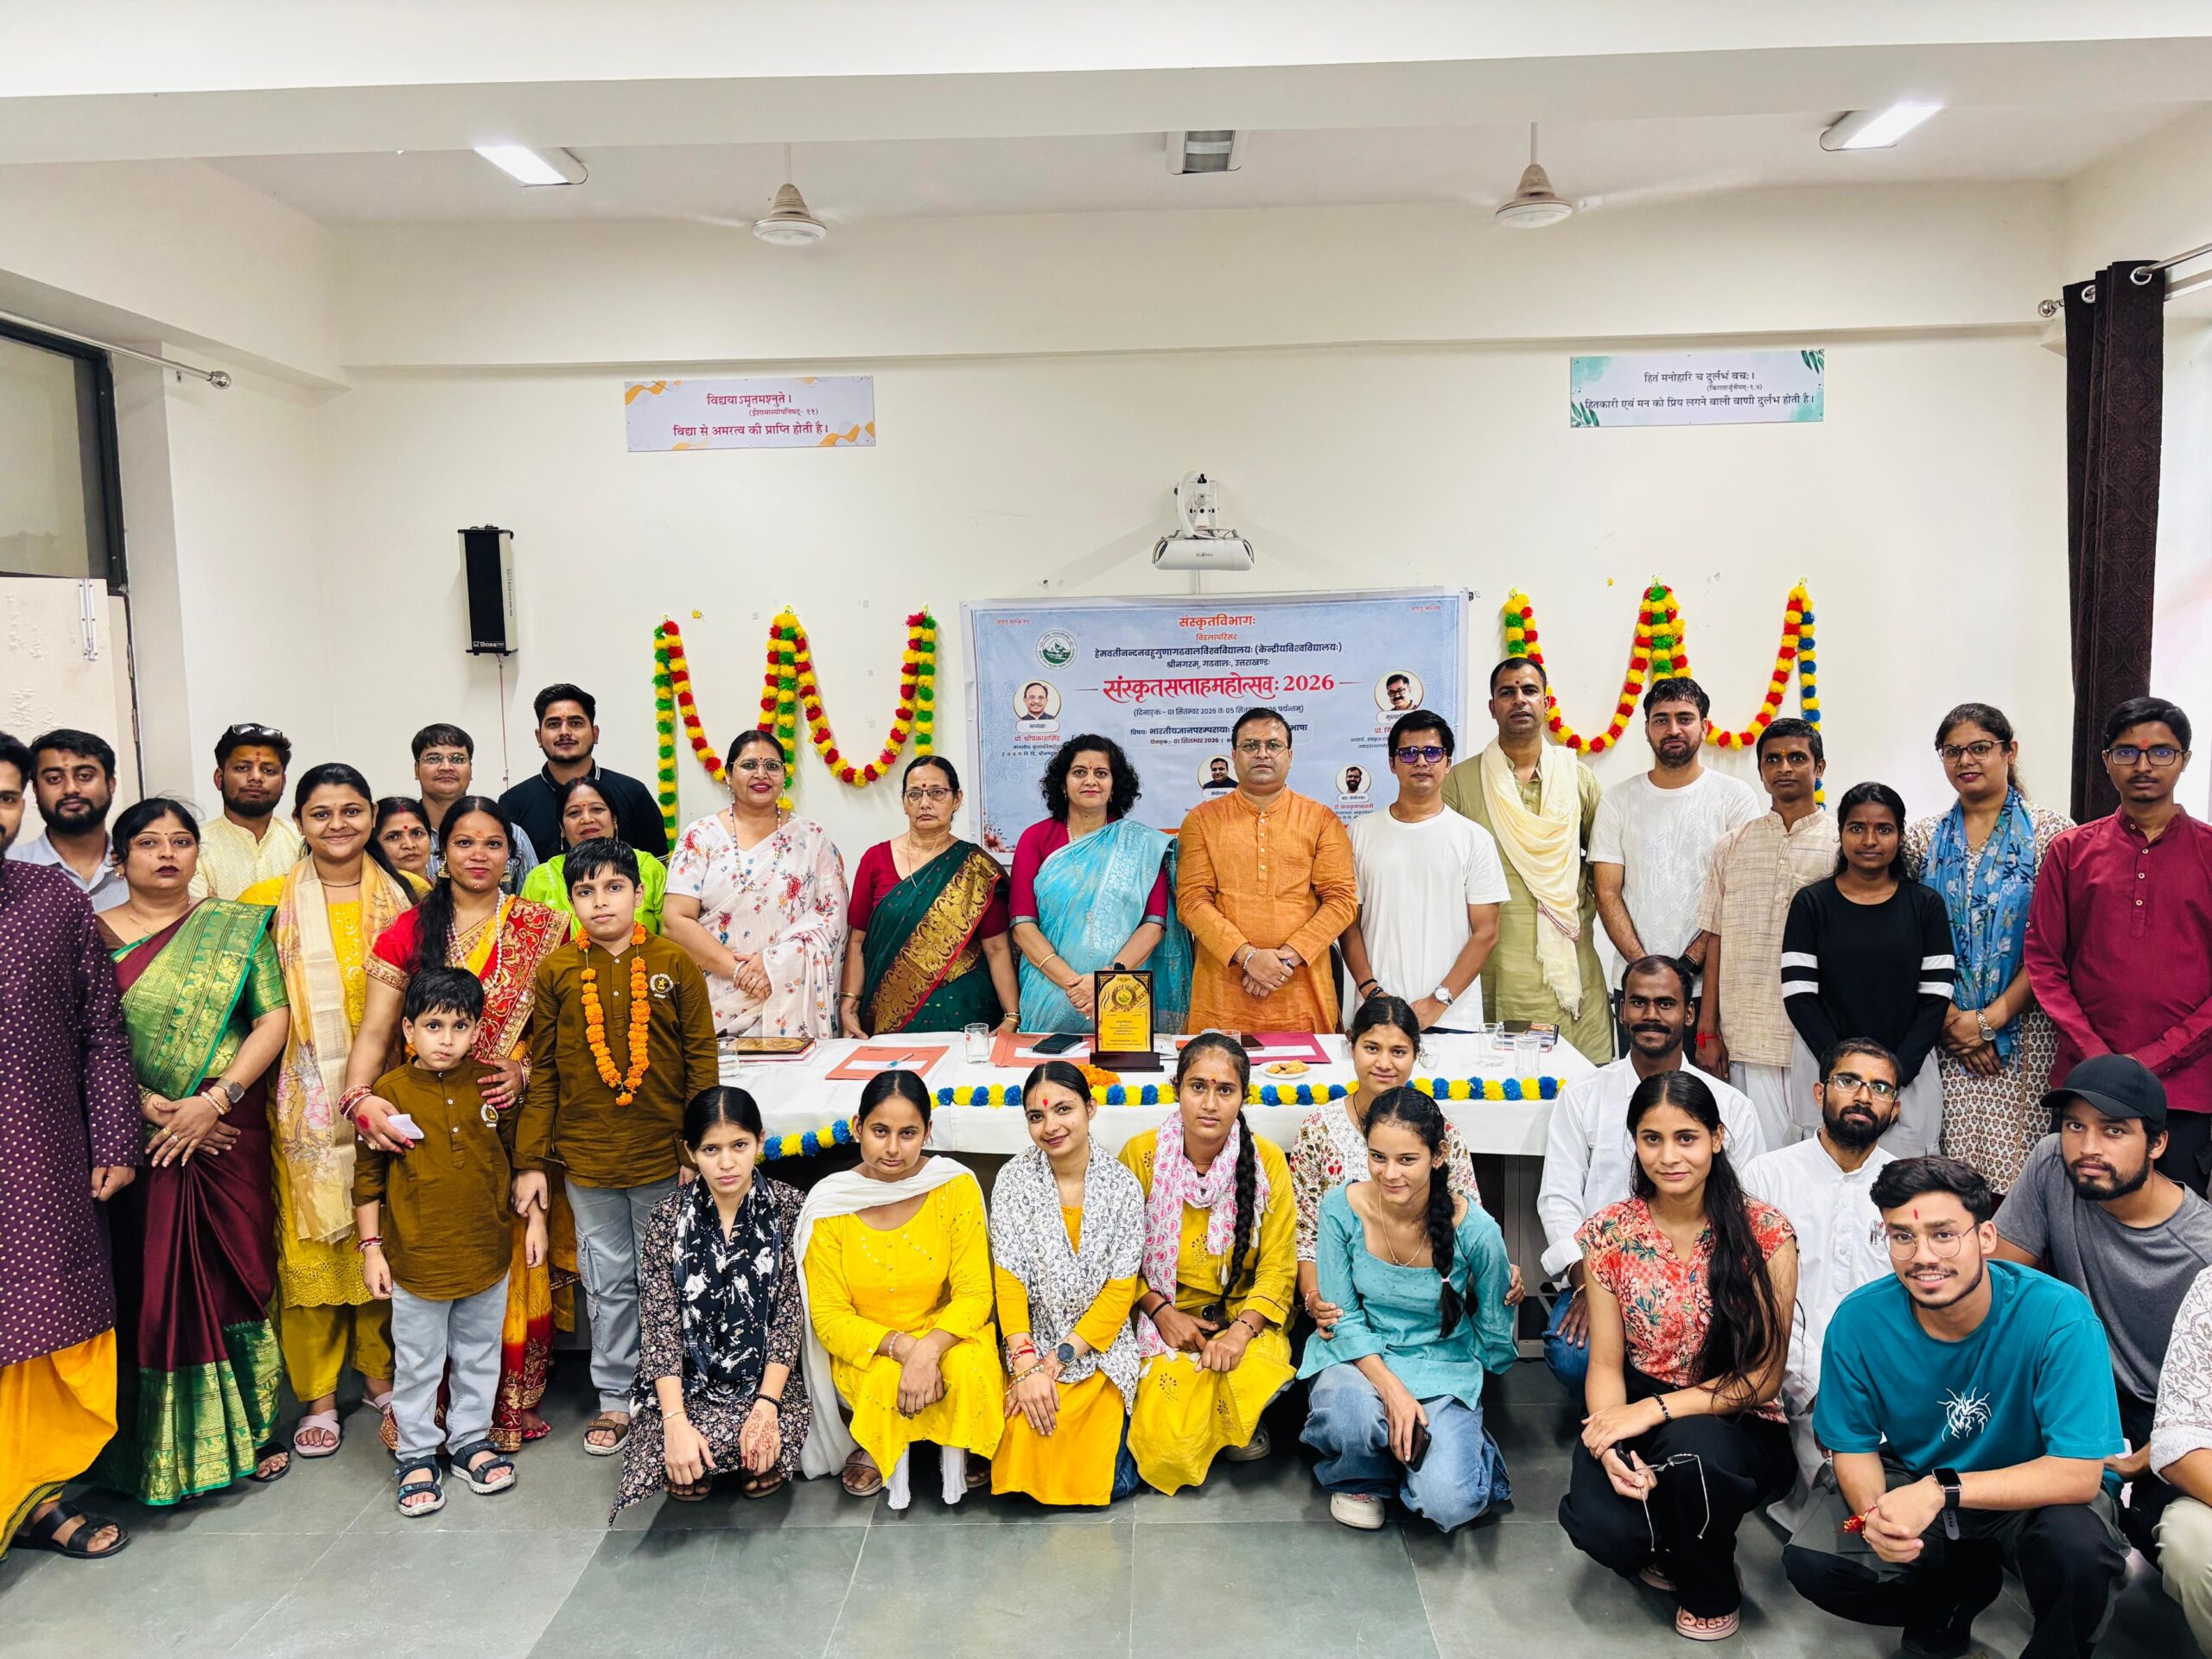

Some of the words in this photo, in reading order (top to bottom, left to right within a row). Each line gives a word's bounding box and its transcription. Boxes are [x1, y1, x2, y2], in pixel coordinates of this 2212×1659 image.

[1643, 372, 1659, 384] हितं
[1661, 371, 1694, 383] मनोहारि
[1695, 372, 1704, 381] च
[1706, 370, 1729, 384] दुर्लभं
[1585, 397, 1618, 410] हितकारी
[1621, 397, 1635, 410] एवं
[1637, 399, 1649, 408] मन
[1652, 397, 1664, 408] को
[1667, 397, 1683, 408] प्रिय
[1686, 395, 1707, 407] लगने
[1709, 395, 1731, 406] वाली
[1732, 394, 1755, 405] वाणी
[1757, 393, 1781, 408] दुर्लभ
[1783, 392, 1801, 405] होती
[673, 424, 697, 436] विद्या
[699, 423, 709, 436] से
[712, 424, 745, 435] अमरत्व
[747, 423, 763, 435] की
[765, 422, 790, 435] प्राप्ति
[792, 422, 813, 435] होती
[1179, 613, 1255, 630] संस्कृतविभागः
[1166, 659, 1201, 669] श्रीनगरम्,
[1235, 658, 1270, 667] उत्तराखण्डः
[1283, 675, 1334, 691] 2026
